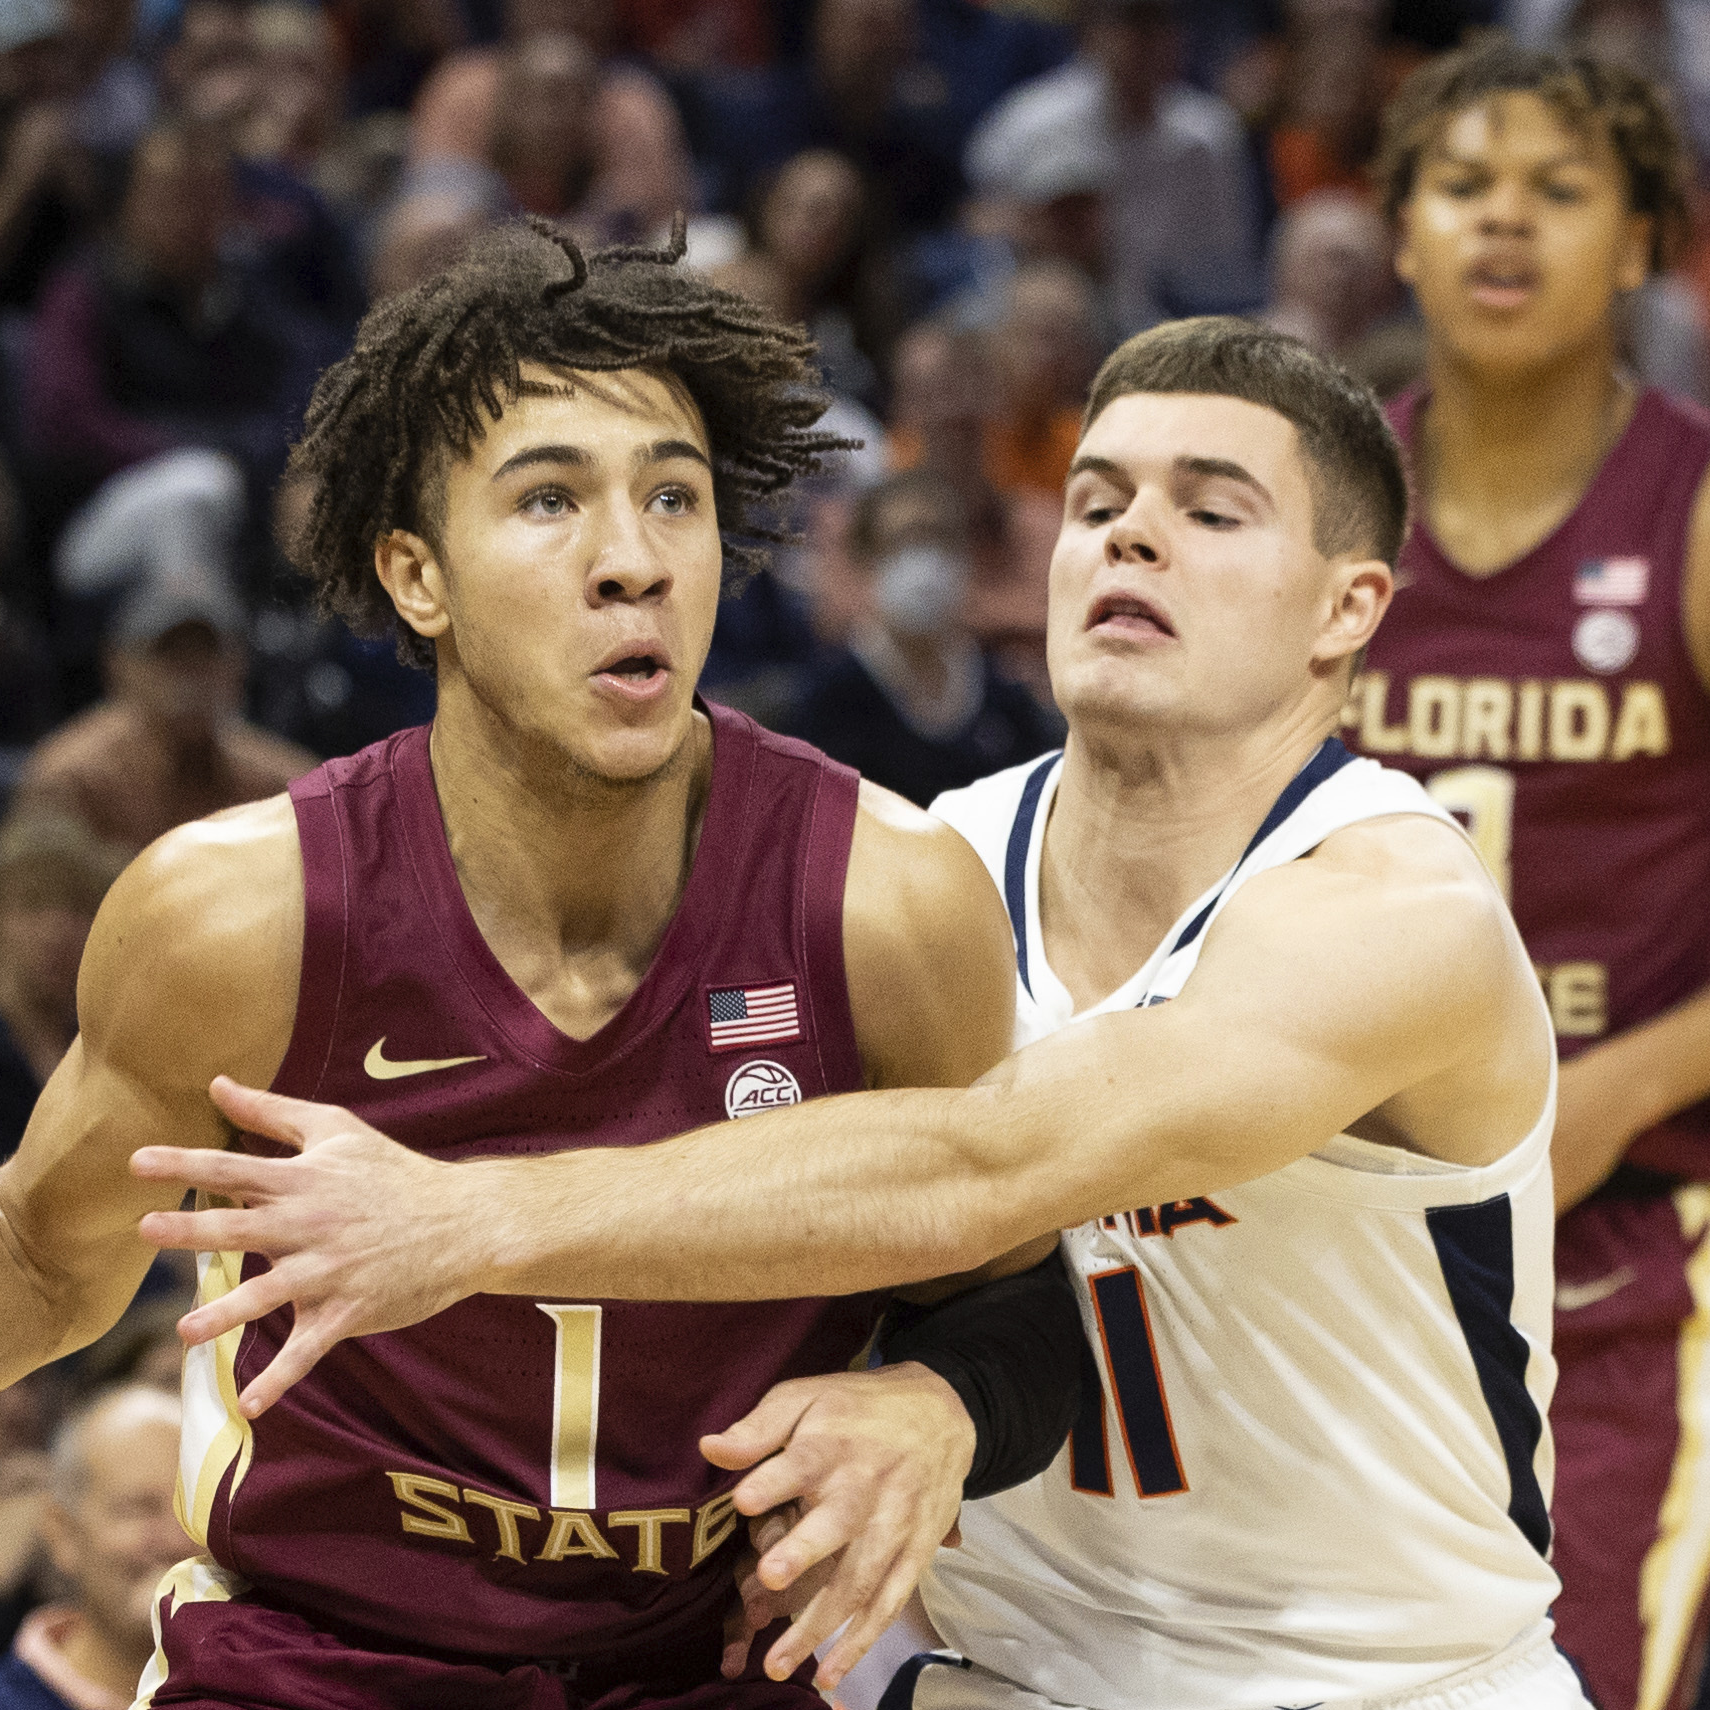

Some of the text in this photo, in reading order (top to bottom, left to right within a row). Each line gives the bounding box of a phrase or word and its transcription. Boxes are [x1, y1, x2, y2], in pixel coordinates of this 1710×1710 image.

[1340, 672, 1671, 763] LORIDA
[739, 1085, 792, 1105] ACC
[535, 1303, 603, 1509] 1
[385, 1471, 738, 1576] STATE
